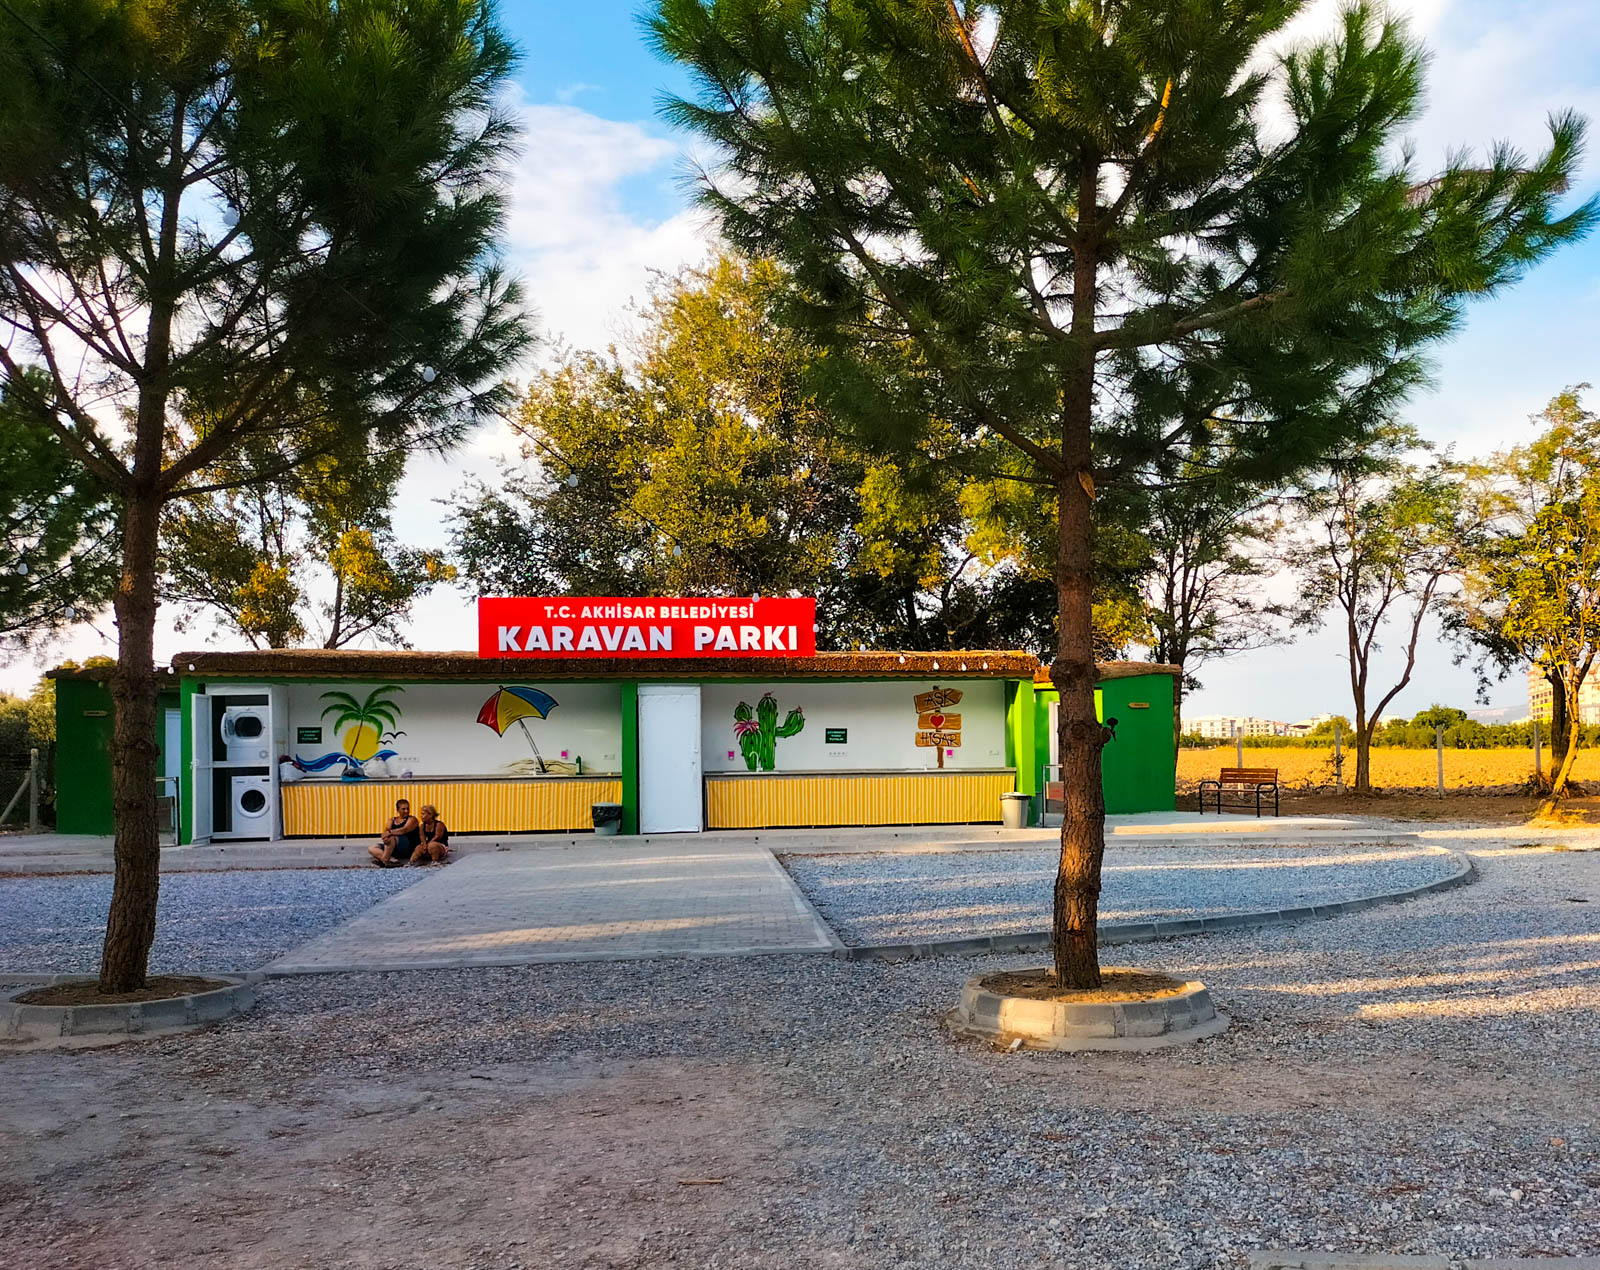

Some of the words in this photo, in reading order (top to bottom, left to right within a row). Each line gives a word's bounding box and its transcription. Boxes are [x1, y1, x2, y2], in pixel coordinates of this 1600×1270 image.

[544, 606, 576, 619] T.C.
[581, 603, 655, 619] AKHİSAR
[660, 603, 754, 619] BELEDİYESİ
[498, 626, 673, 652] KARAVAN
[694, 626, 798, 651] PARKI
